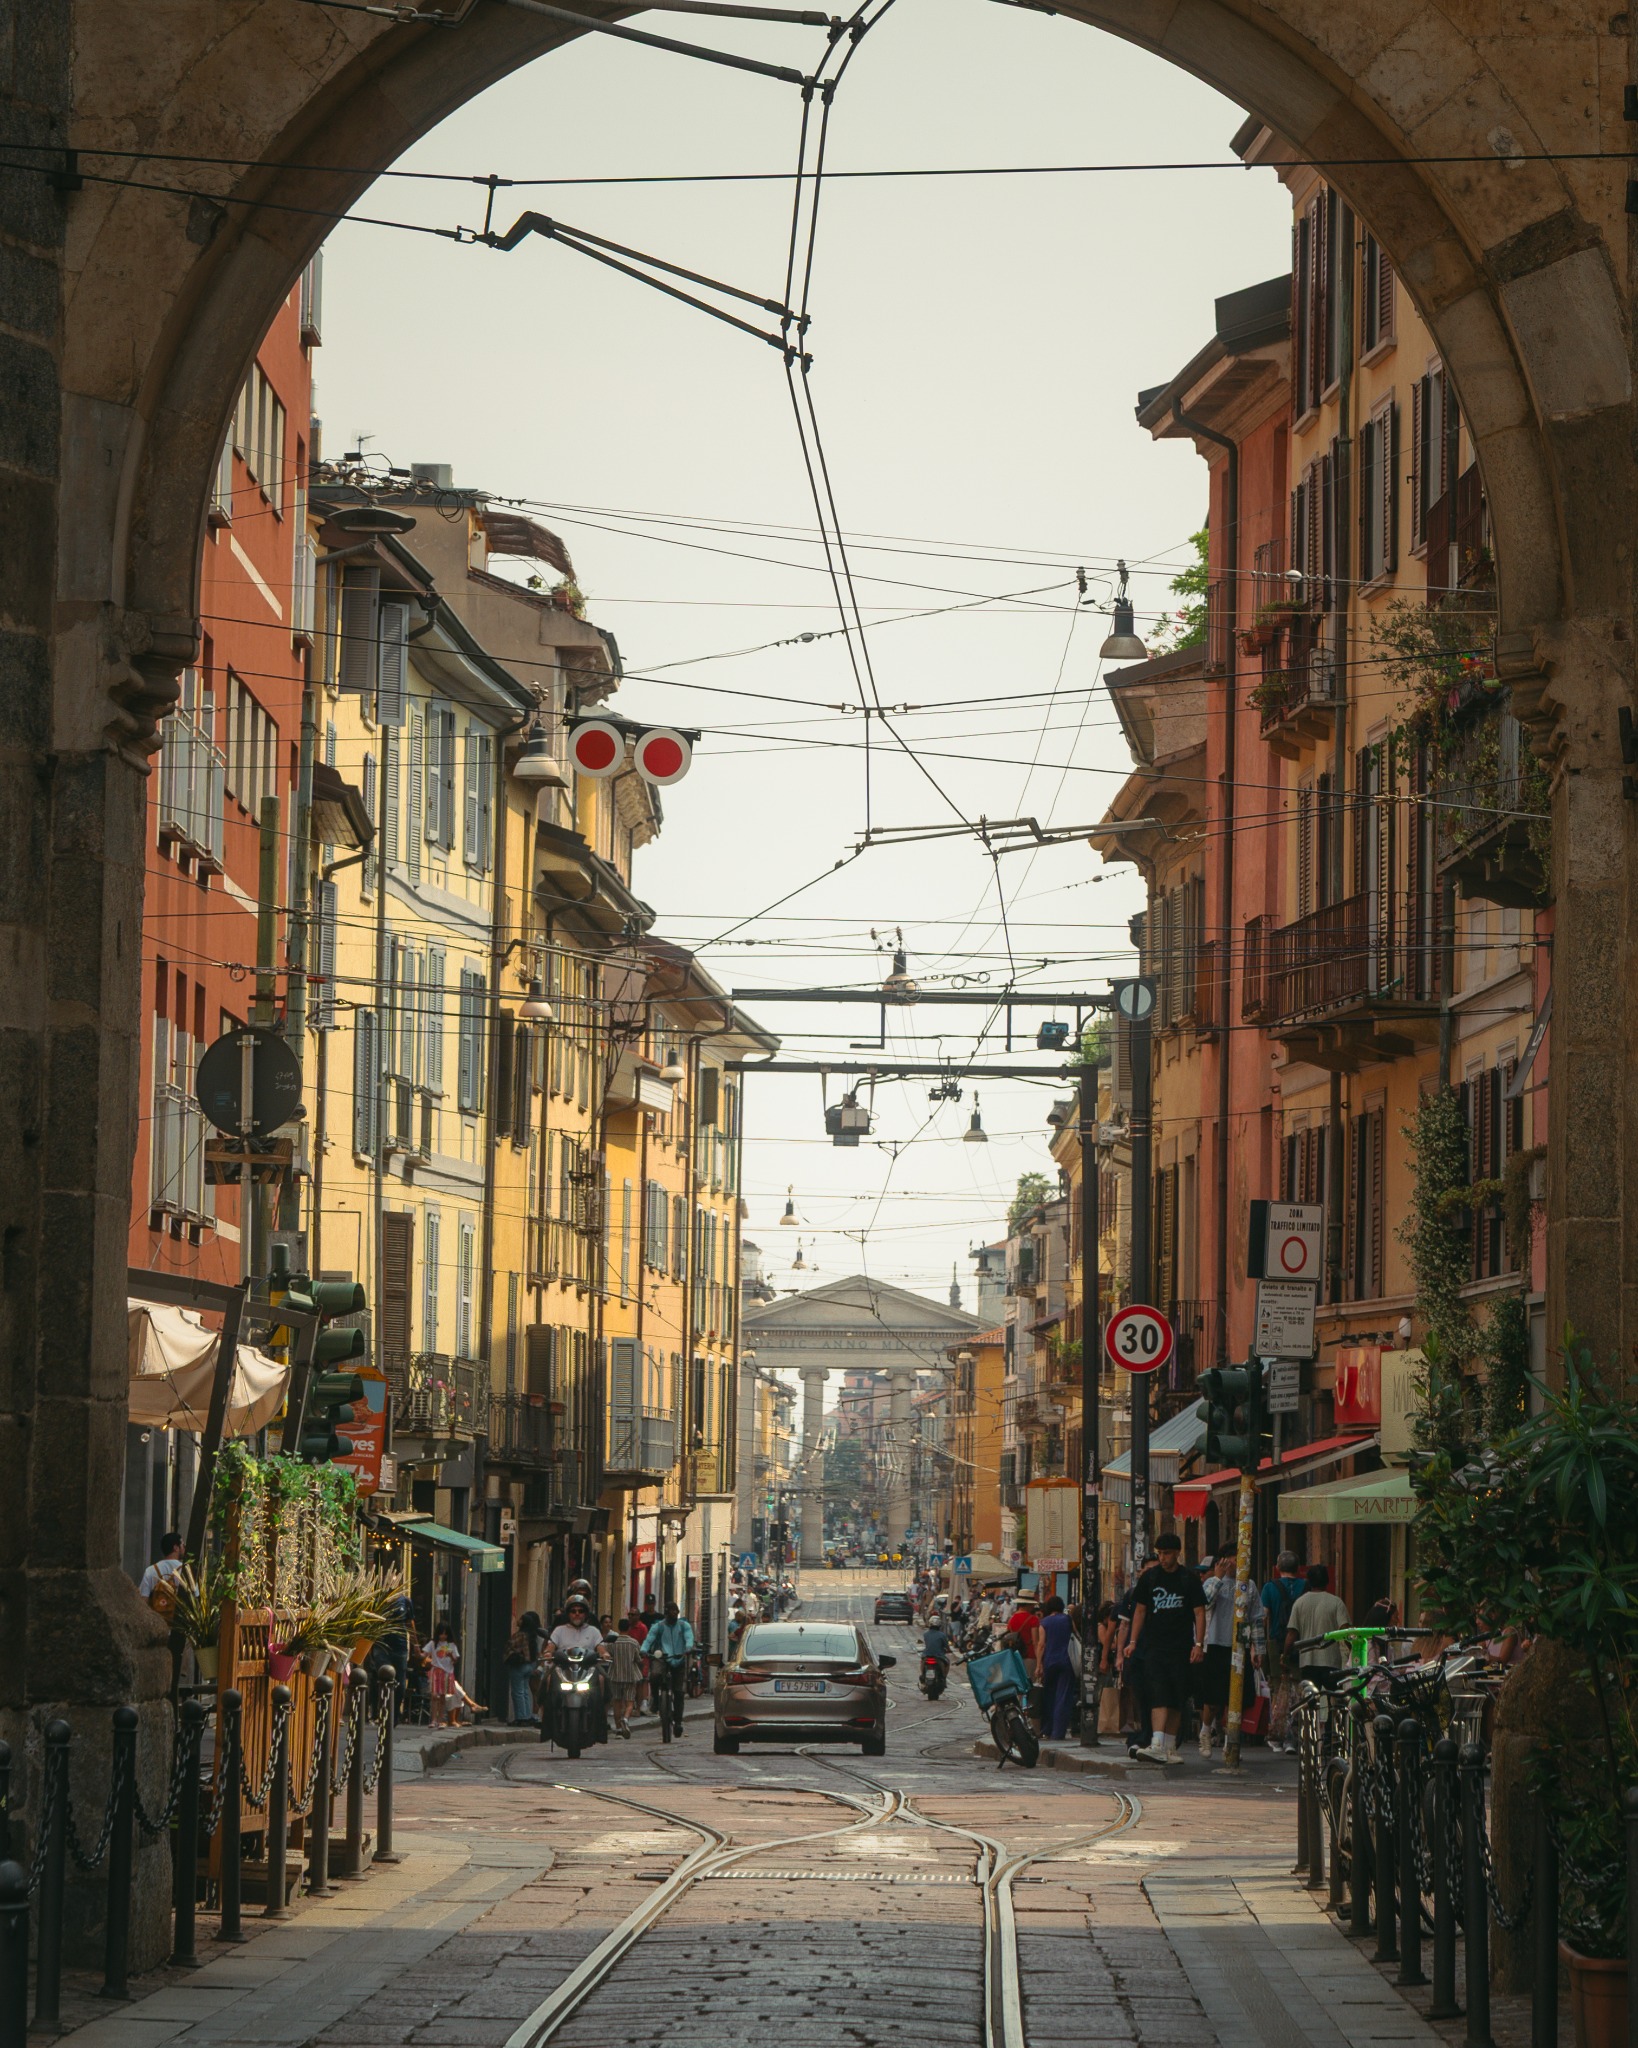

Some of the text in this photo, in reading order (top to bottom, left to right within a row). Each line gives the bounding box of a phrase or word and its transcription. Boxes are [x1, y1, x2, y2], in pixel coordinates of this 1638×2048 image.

[1289, 1209, 1303, 1218] ZONA
[1271, 1221, 1320, 1232] TRAFFICO LIMITATO
[822, 1340, 867, 1349] ANNO
[1121, 1323, 1159, 1355] 30
[1153, 1587, 1184, 1613] Patta
